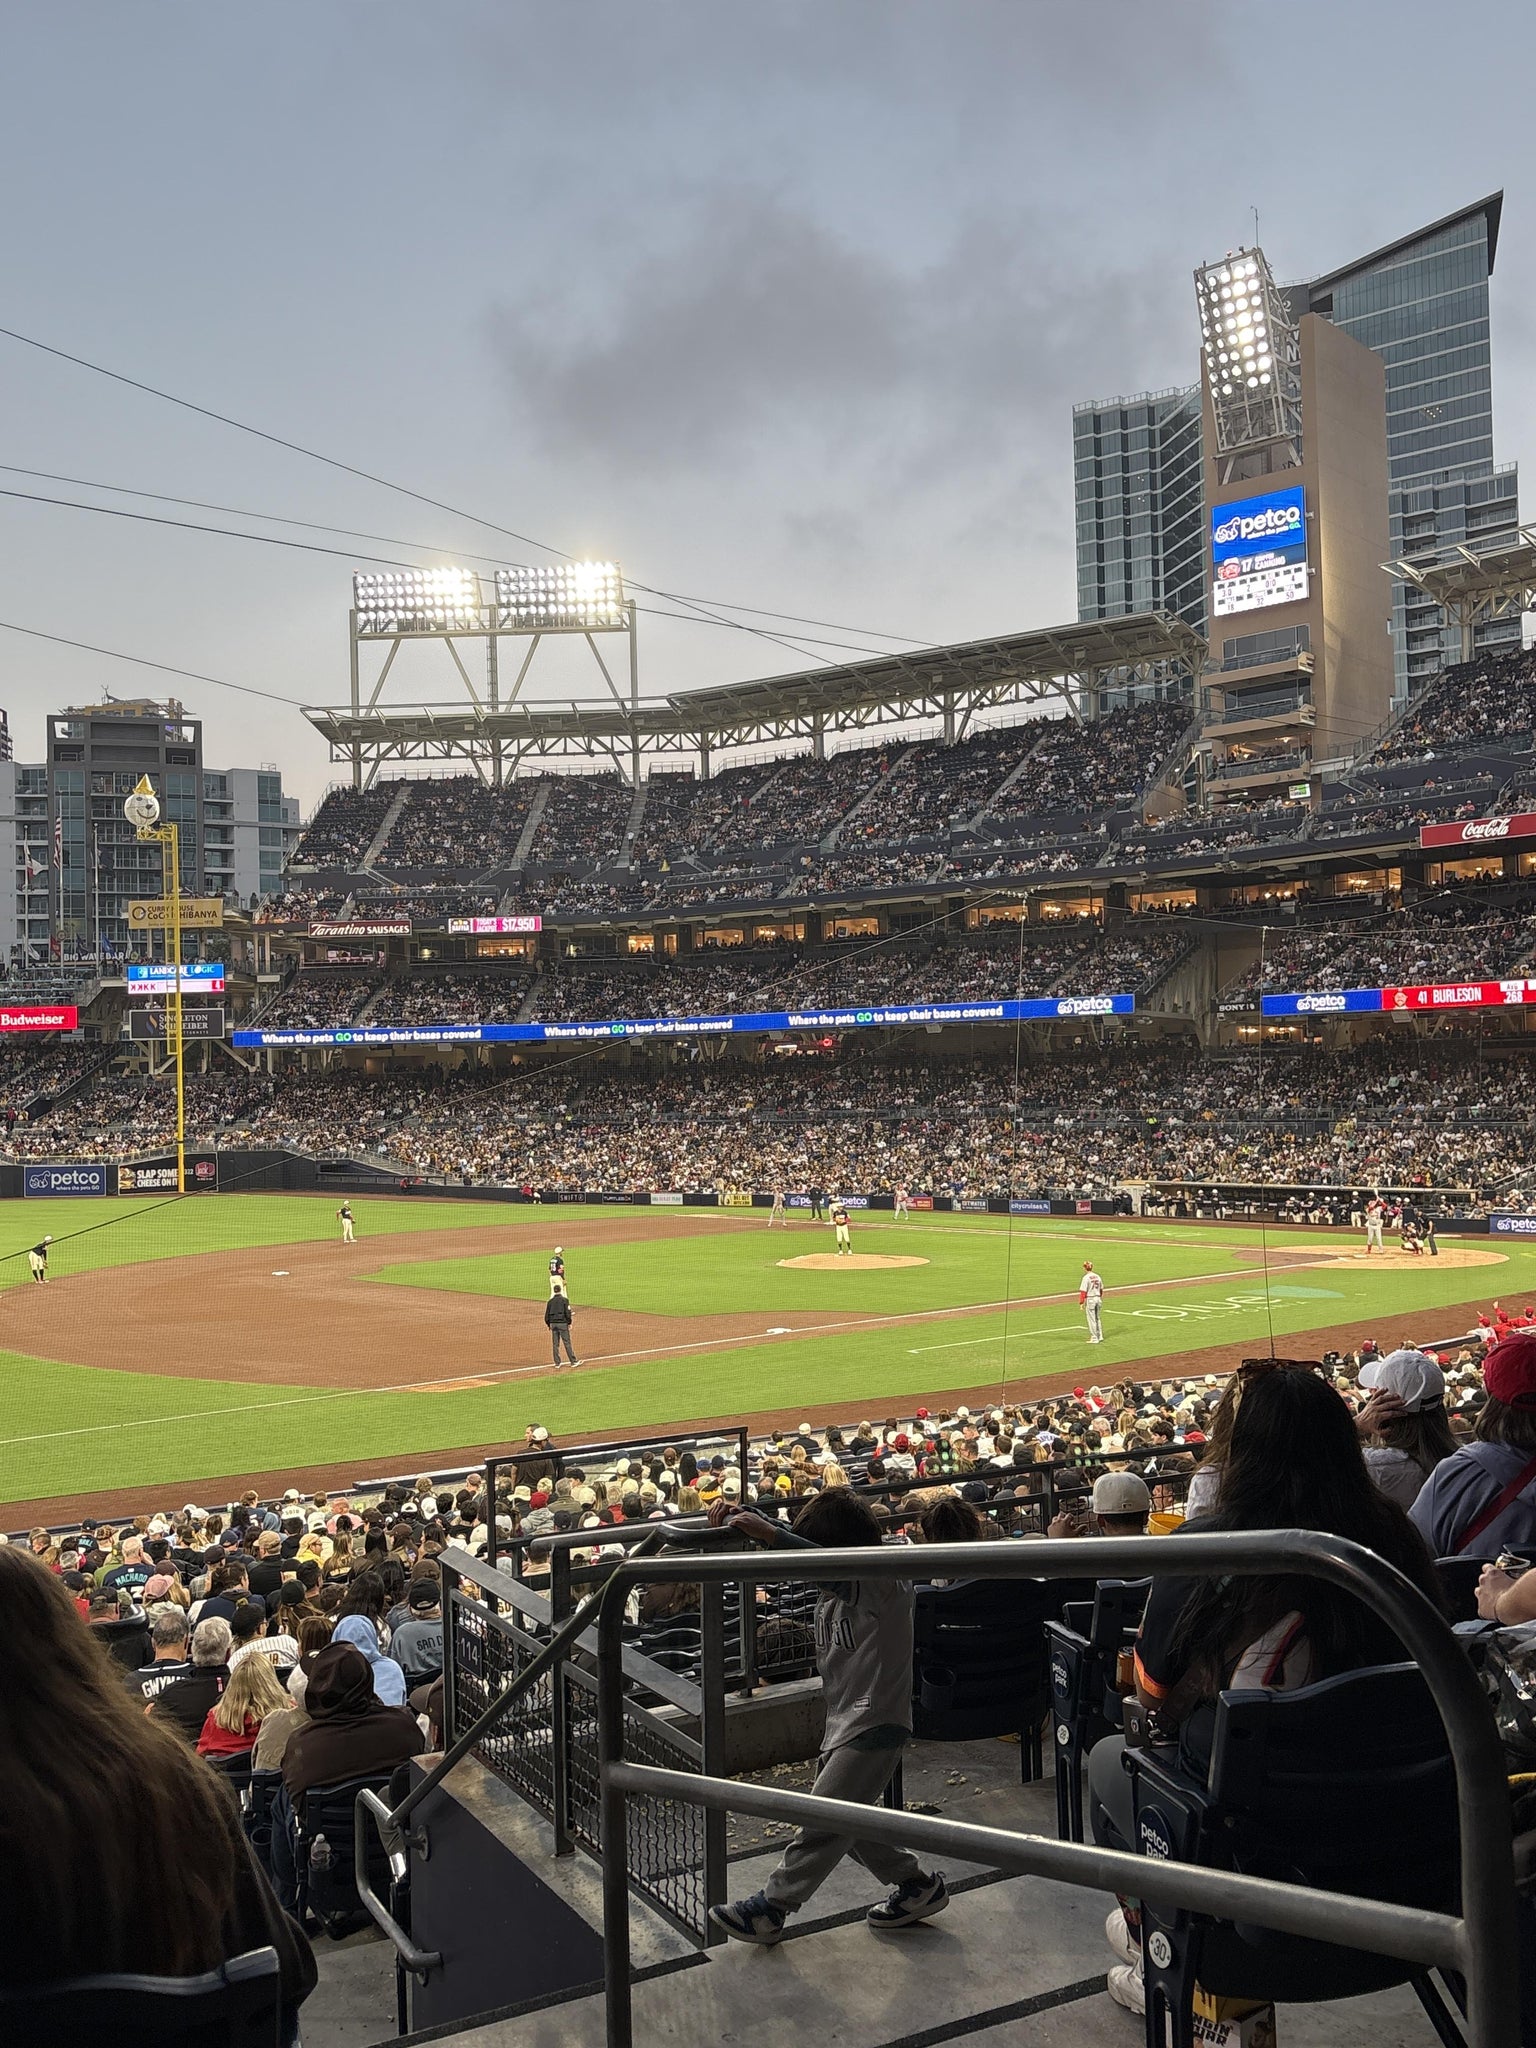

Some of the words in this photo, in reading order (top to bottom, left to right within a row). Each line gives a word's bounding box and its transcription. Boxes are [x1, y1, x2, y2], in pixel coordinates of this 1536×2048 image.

[1241, 506, 1300, 538] petco
[1241, 558, 1252, 572] 17
[311, 924, 365, 935] Tarantino
[367, 925, 409, 933] SAUSAGES
[1311, 995, 1345, 1010] petco
[1418, 991, 1427, 1004] 41
[1433, 987, 1482, 1003] BURLESON
[1504, 991, 1522, 1003] .268
[1074, 997, 1113, 1013] petco
[1, 1014, 64, 1025] Budweiser
[788, 1016, 818, 1026] Where
[819, 1015, 834, 1024] the
[835, 1015, 855, 1025] pets
[856, 1013, 872, 1023] GO
[873, 1013, 883, 1022] to
[884, 1012, 908, 1023] keep
[909, 1010, 932, 1020] their
[933, 1009, 961, 1019] bases
[962, 1006, 1003, 1017] covered
[544, 1027, 576, 1036] Where
[578, 1026, 592, 1036] the
[594, 1027, 611, 1037] pets
[611, 1024, 624, 1034] GO
[626, 1025, 634, 1033] to
[635, 1024, 654, 1034] keep
[655, 1022, 674, 1032] their
[675, 1022, 698, 1031] bases
[700, 1020, 732, 1030] covered
[262, 1034, 294, 1043] Where
[295, 1034, 311, 1043] the
[312, 1034, 334, 1044] pets
[336, 1032, 352, 1042] GO
[353, 1033, 364, 1042] to
[365, 1032, 388, 1042] keep
[390, 1031, 412, 1040] their
[413, 1031, 441, 1040] bases
[442, 1029, 481, 1039] covered
[51, 1170, 100, 1188] petco
[137, 1170, 157, 1179] SLAP
[158, 1169, 178, 1178] SOME
[137, 1179, 160, 1187] CHEESE
[843, 1196, 867, 1205] petco
[1512, 1218, 1536, 1230] petc
[115, 1573, 148, 1586] MACHADO
[416, 1638, 436, 1651] SAN
[1052, 1662, 1067, 1678] petco
[141, 1675, 186, 1698] GWYN
[1055, 1674, 1067, 1688] park
[1141, 1822, 1168, 1855] petco
[1146, 1842, 1168, 1860] par
[1153, 1938, 1167, 1962] 30
